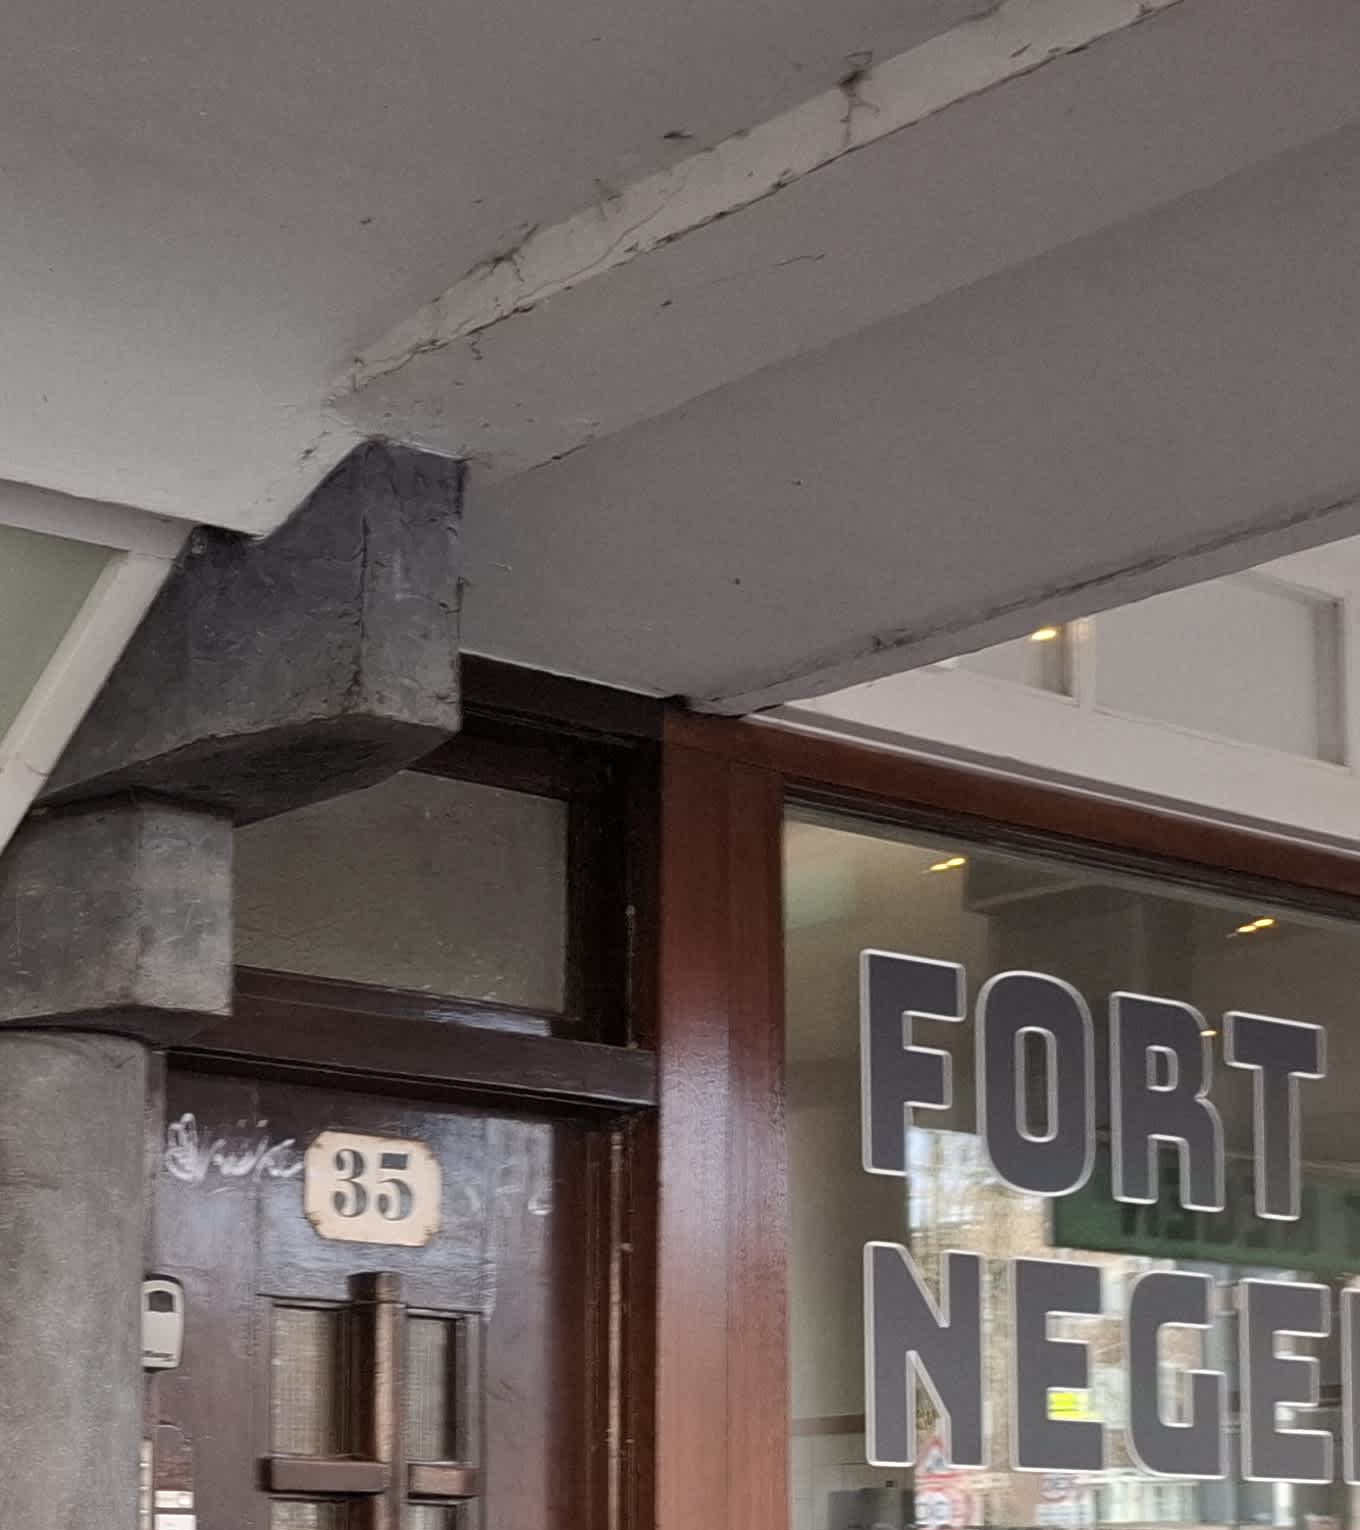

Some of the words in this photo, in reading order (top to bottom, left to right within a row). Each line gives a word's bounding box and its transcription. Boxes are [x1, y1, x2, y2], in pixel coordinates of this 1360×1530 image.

[330, 1147, 415, 1222] 35
[859, 948, 1328, 1221] FORT
[863, 1240, 1360, 1485] NEGE
